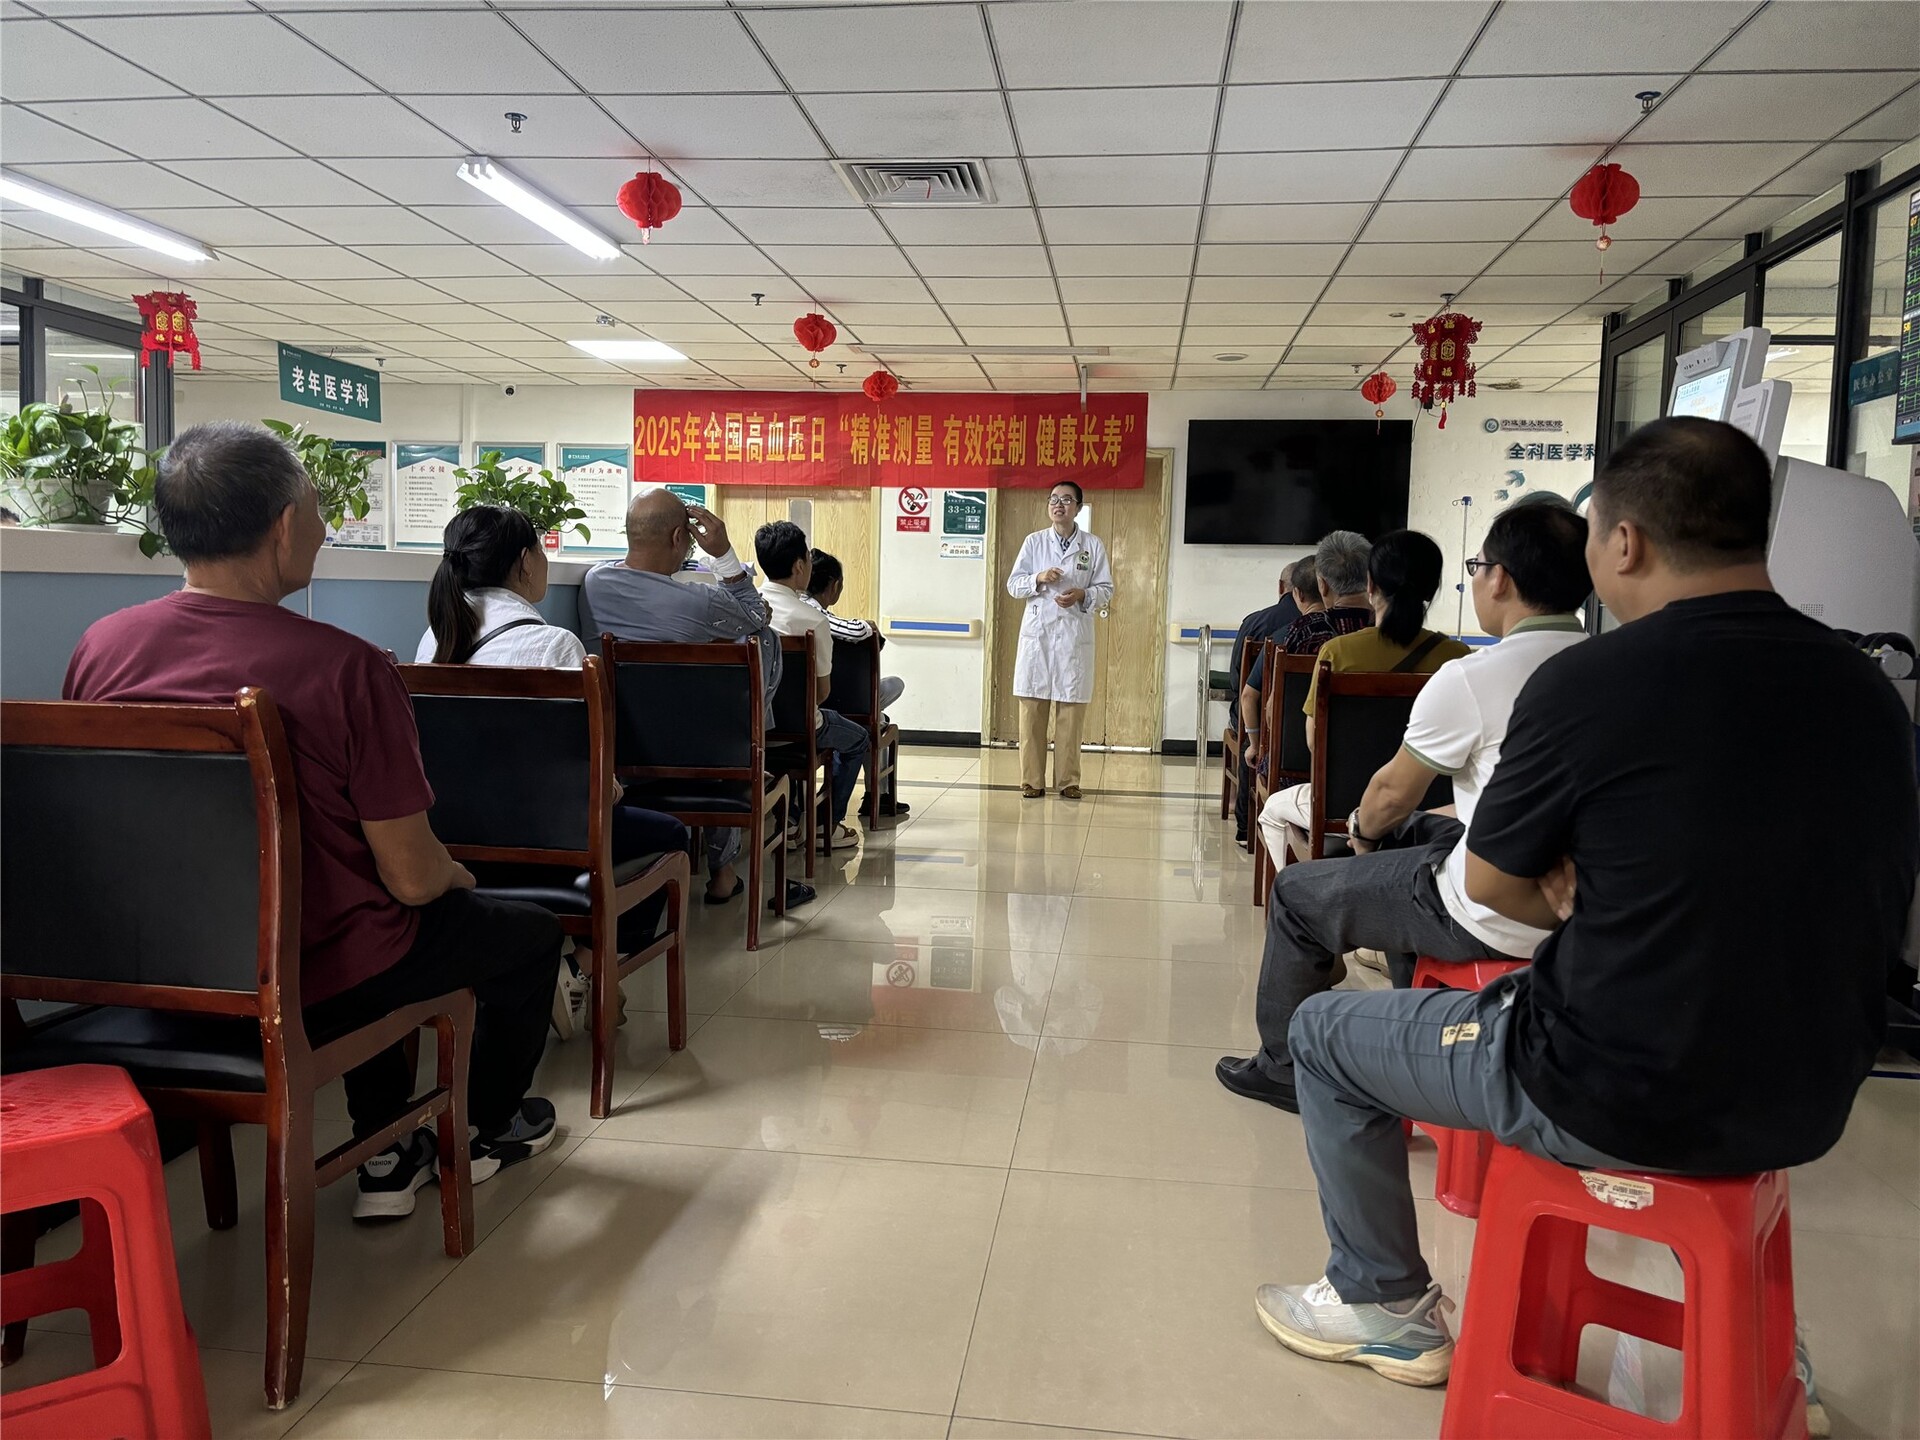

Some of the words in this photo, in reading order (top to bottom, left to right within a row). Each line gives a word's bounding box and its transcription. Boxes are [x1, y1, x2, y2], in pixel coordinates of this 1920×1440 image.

[292, 365, 369, 408] 老年医学科
[634, 411, 825, 463] 2025年全国高血压日
[943, 414, 1027, 467] 有效控制
[1036, 414, 1135, 467] 健康长寿”
